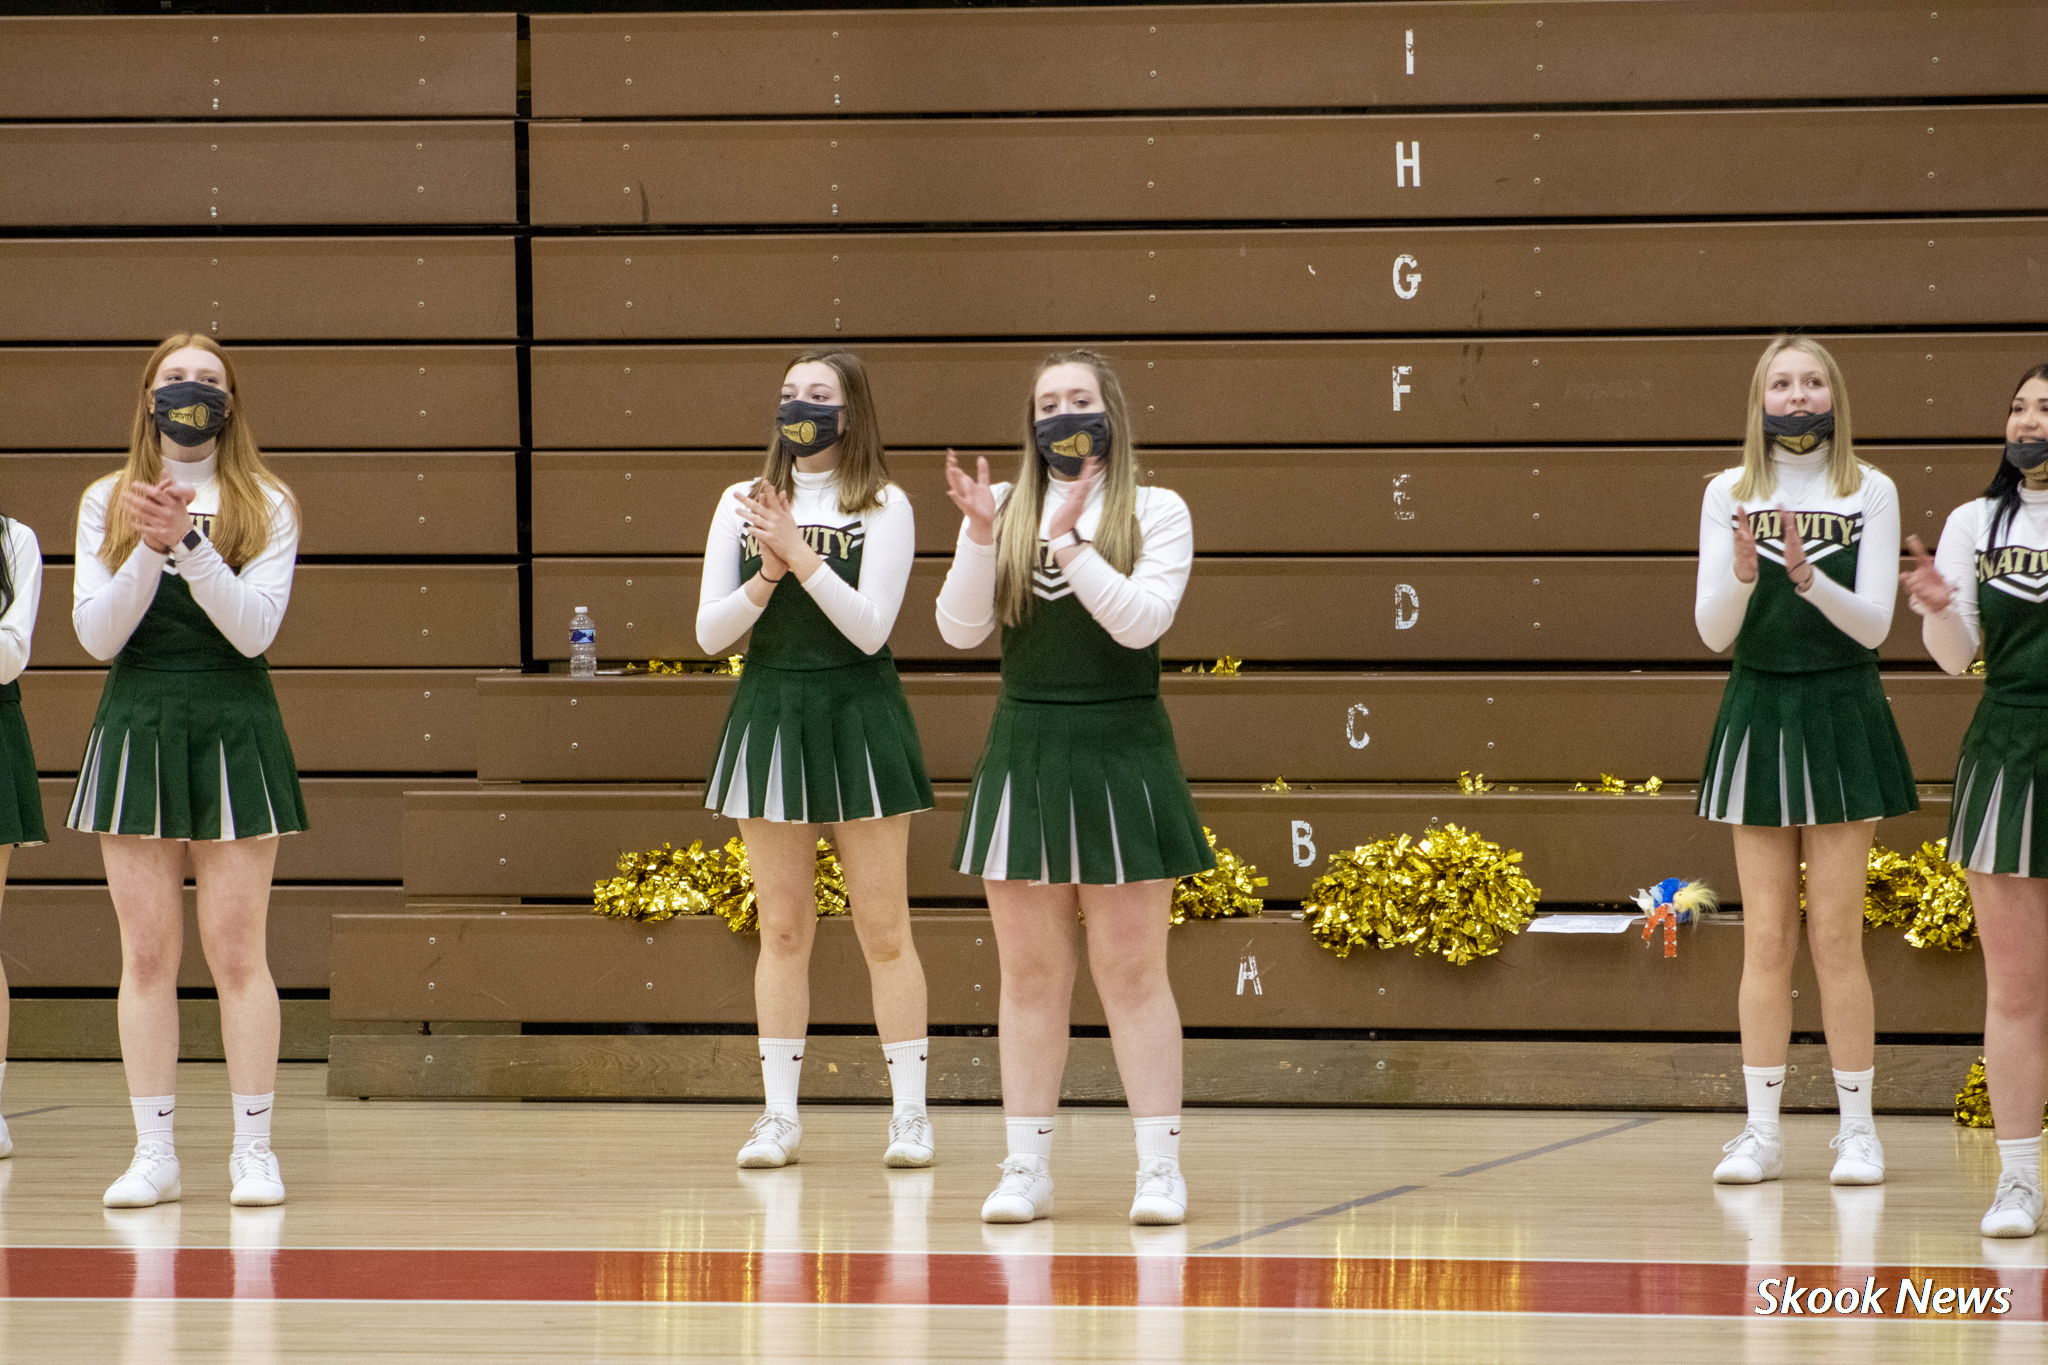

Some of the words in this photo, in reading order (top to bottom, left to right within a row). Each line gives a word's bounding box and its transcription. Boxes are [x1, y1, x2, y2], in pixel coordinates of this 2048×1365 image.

[1405, 29, 1414, 75] I
[1396, 141, 1420, 187] H
[1392, 254, 1421, 299] G
[1392, 366, 1412, 411] F
[1393, 474, 1415, 520] E
[1394, 584, 1419, 629] D
[1346, 703, 1370, 749] C
[1291, 820, 1316, 867] B
[1236, 953, 1262, 995] A
